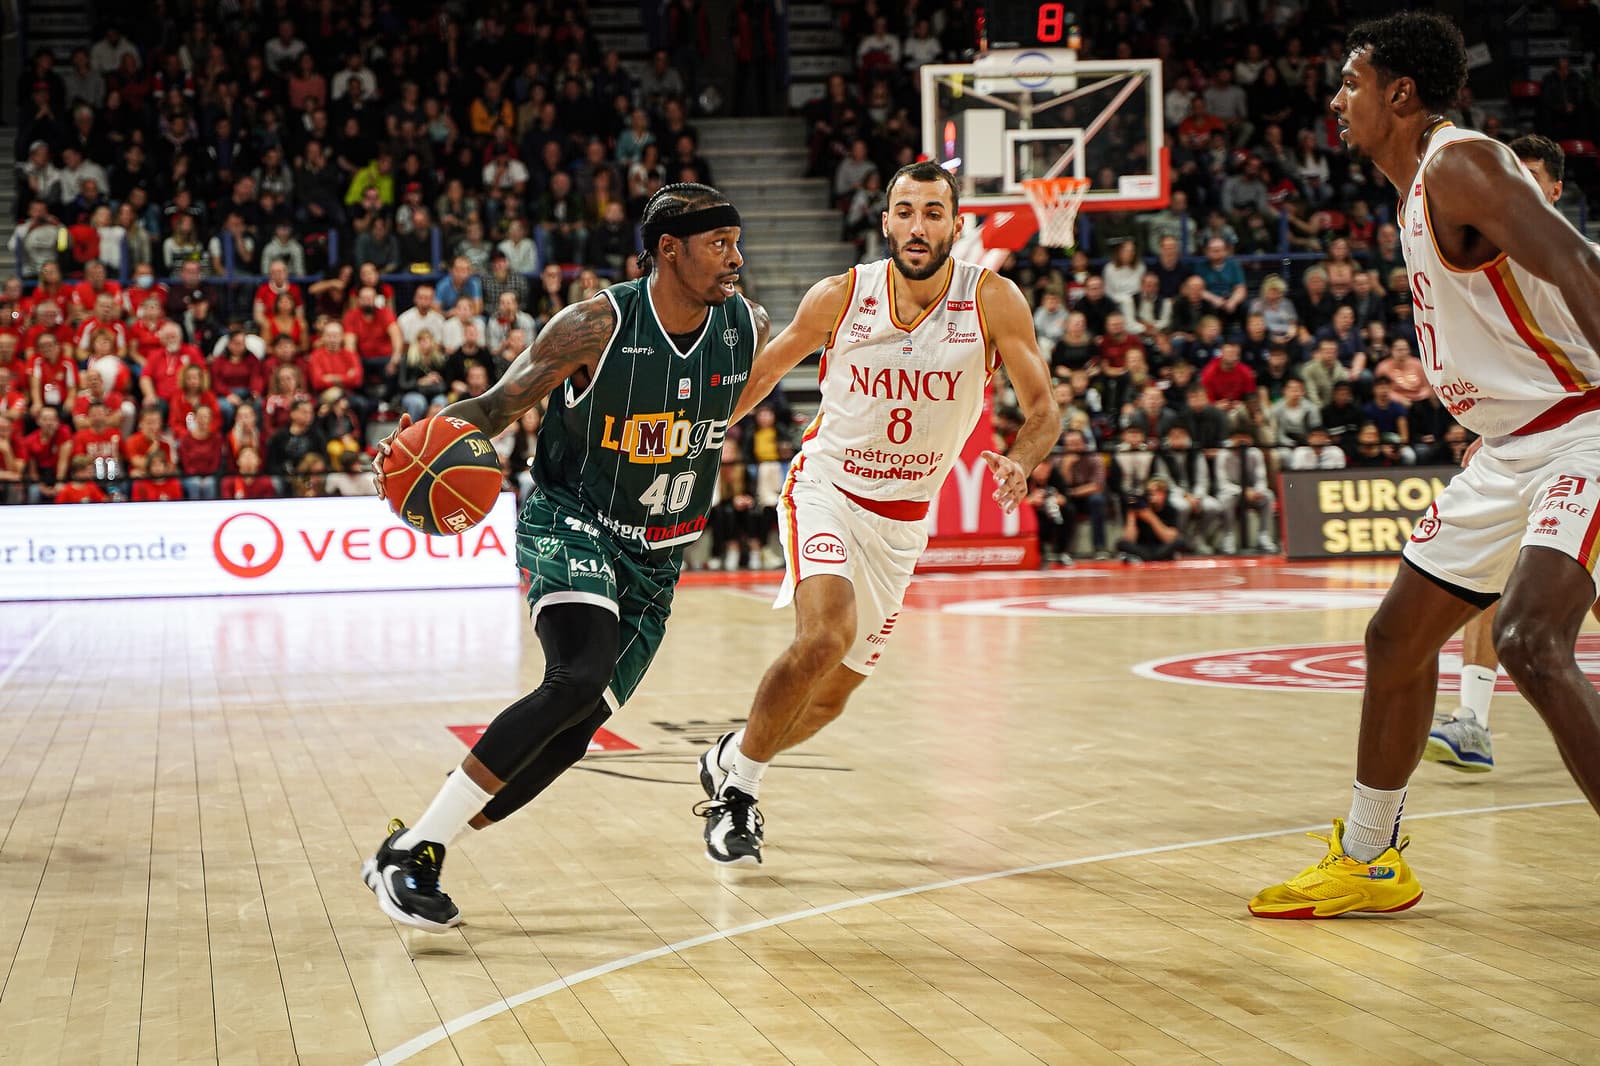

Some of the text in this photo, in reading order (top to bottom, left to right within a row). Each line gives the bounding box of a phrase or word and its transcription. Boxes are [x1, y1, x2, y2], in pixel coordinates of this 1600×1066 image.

[1037, 3, 1064, 42] 8
[622, 346, 647, 355] CRAFT
[850, 364, 963, 402] NANCY
[886, 407, 913, 445] 8
[638, 470, 697, 516] 40
[28, 538, 56, 564] le
[67, 536, 187, 563] monde
[299, 526, 507, 562] VEOLIA
[805, 543, 845, 557] cora
[569, 558, 616, 587] KIA
